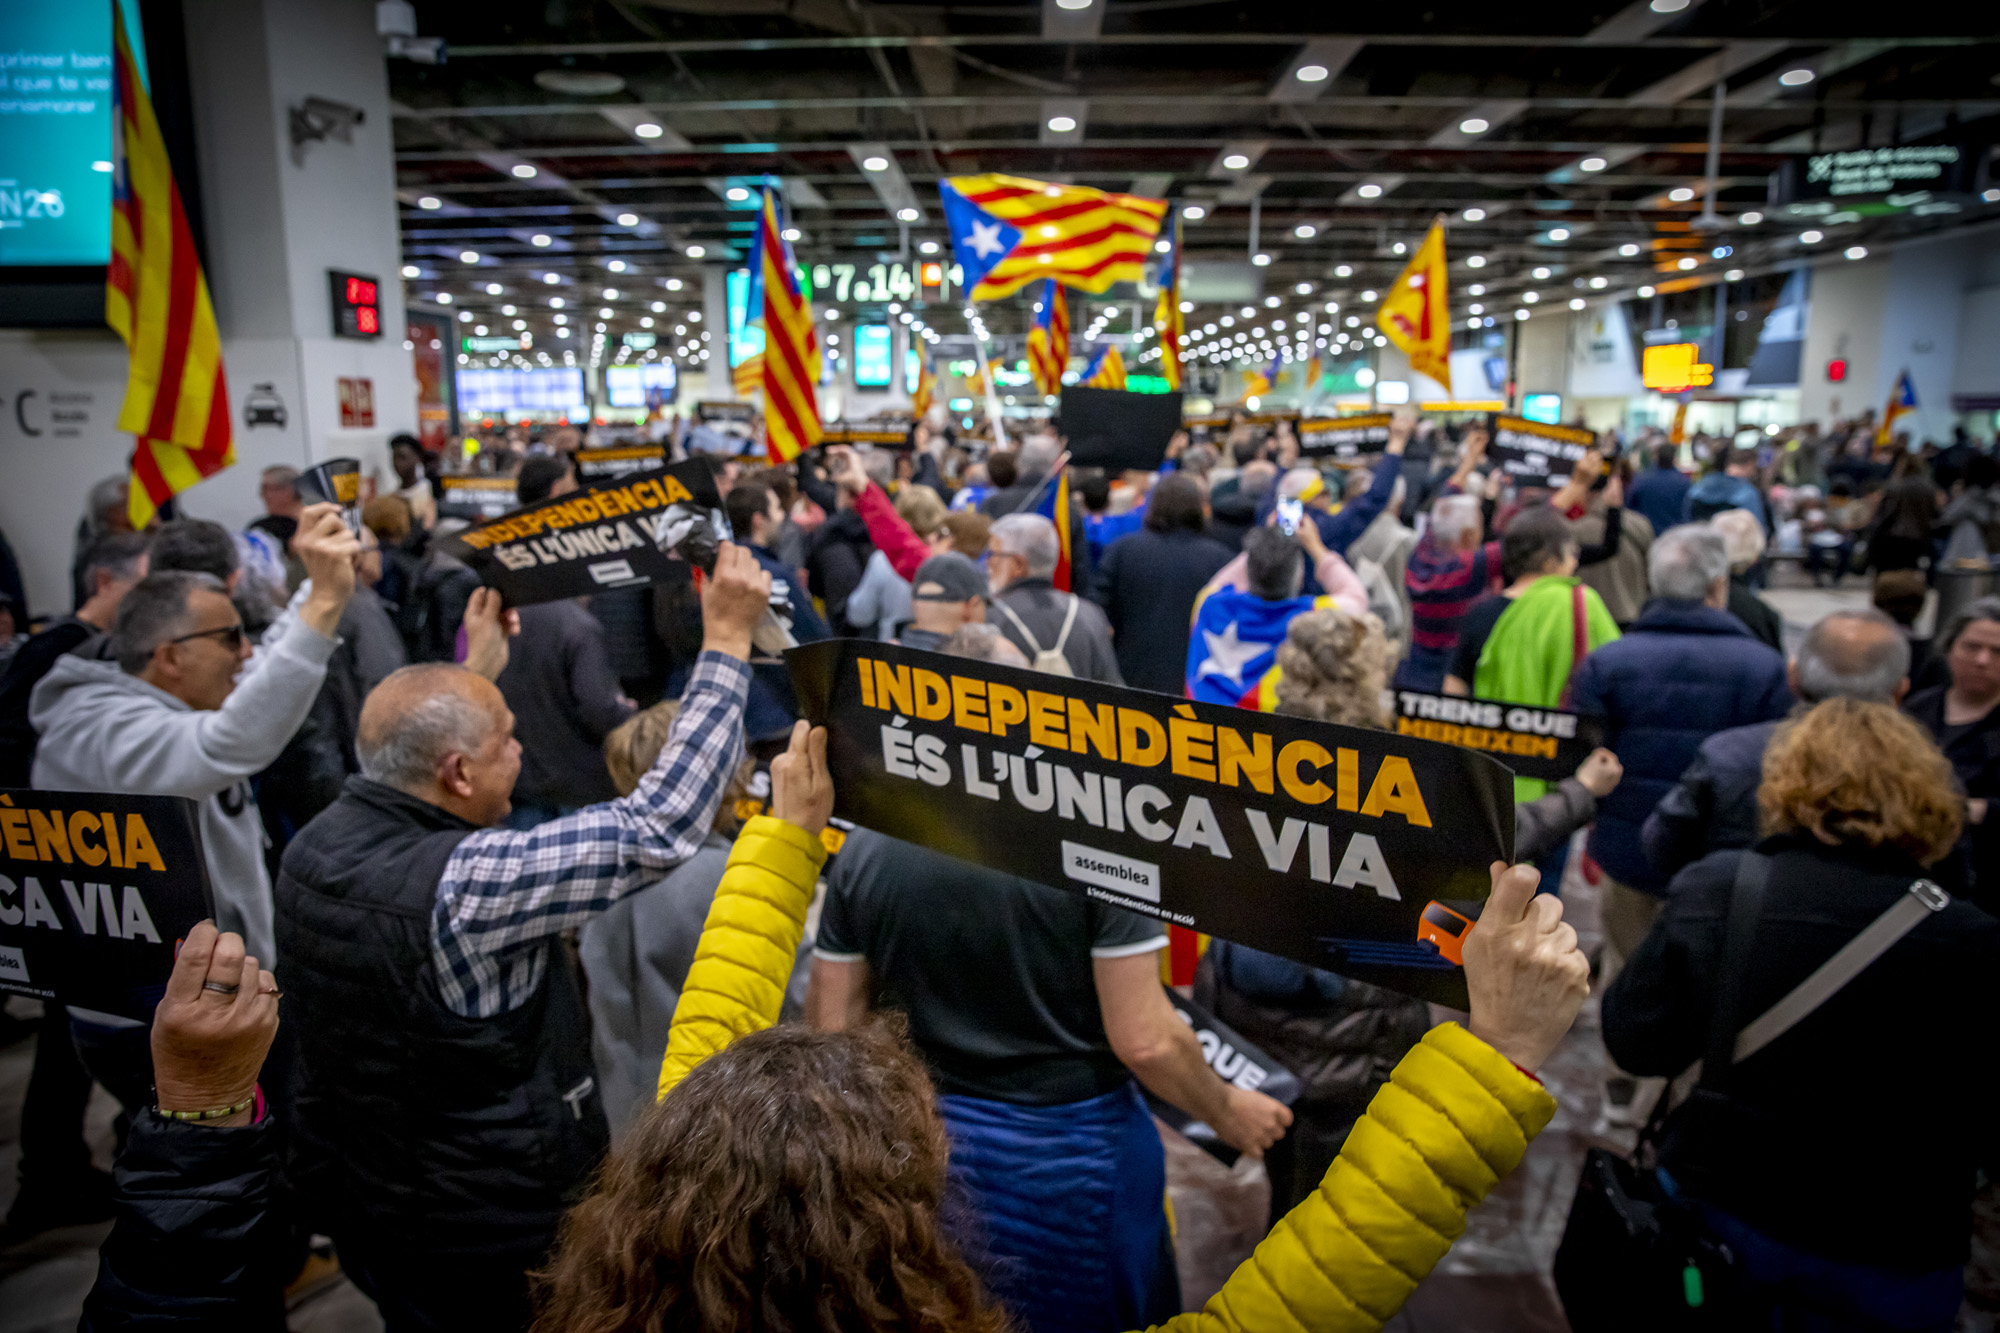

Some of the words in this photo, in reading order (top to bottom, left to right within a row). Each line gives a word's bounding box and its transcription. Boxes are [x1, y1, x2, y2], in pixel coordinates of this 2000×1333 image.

[857, 657, 1432, 828] INDEPENDÈNCIA
[1400, 691, 1503, 728] TRENS
[1506, 708, 1578, 739] QUE
[0, 793, 167, 871] ÈNCIA
[881, 714, 951, 786] ÉS
[961, 744, 1232, 859] L'ÚNICA
[1245, 807, 1401, 901] VIA
[1075, 856, 1149, 886] assemblea
[60, 879, 163, 944] VIA
